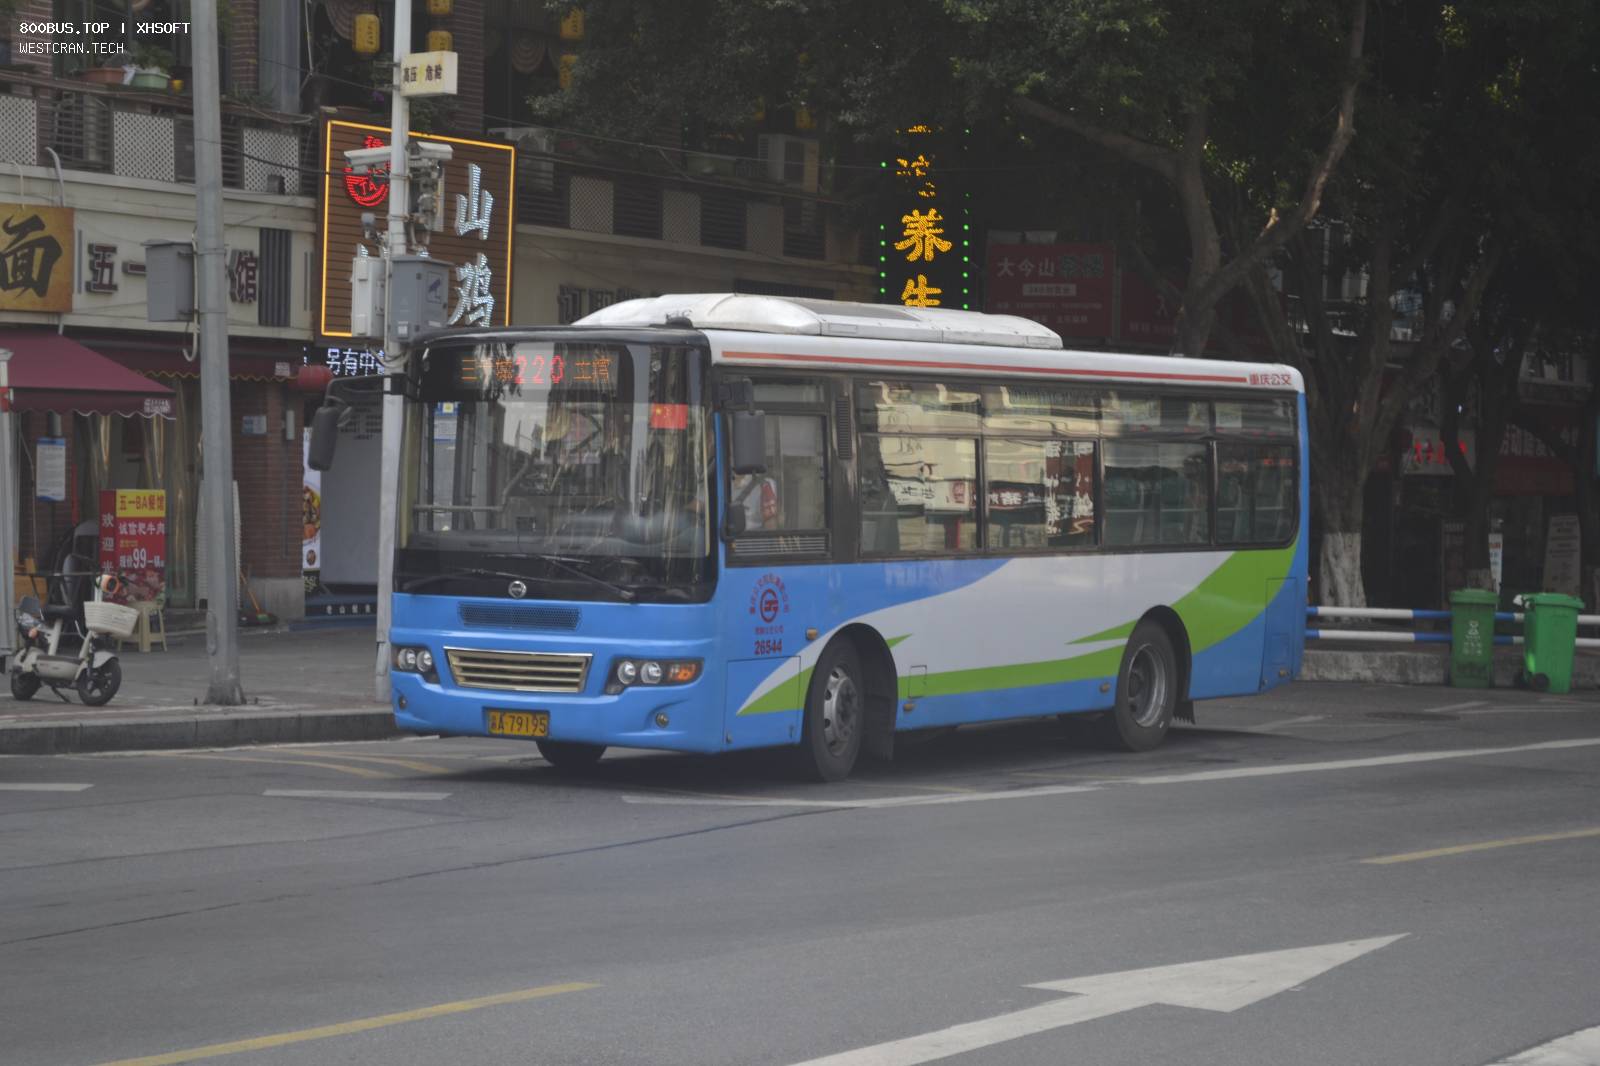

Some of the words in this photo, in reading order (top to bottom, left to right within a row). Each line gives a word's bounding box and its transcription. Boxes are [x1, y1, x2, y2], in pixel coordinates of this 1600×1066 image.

[0, 213, 63, 299] 面
[514, 354, 565, 384] 220
[1249, 373, 1292, 386] 重庆公交
[754, 639, 783, 656] 26544
